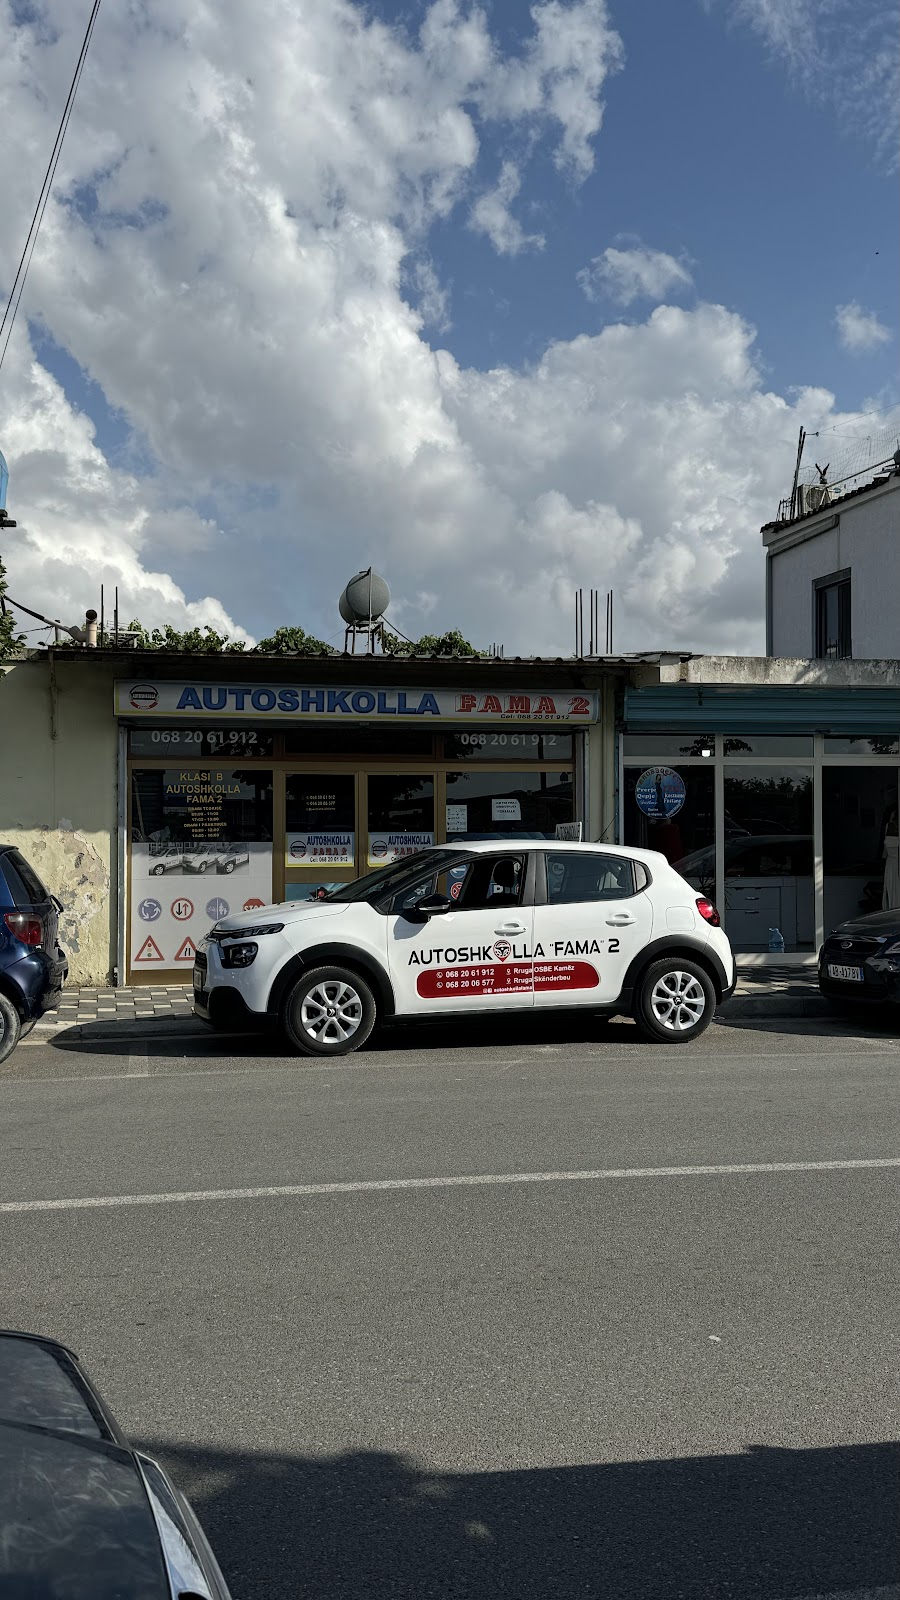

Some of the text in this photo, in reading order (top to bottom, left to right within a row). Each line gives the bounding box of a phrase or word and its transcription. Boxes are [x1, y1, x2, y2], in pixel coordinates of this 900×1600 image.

[176, 687, 441, 715] AUTOSHKOLLA
[455, 694, 590, 714] FAMA 2
[151, 730, 258, 744] 068 20 61 912
[460, 734, 556, 746] 068 20 61 912
[166, 785, 240, 793] AUTOSHKOLLA
[306, 836, 351, 845] AUTOSHKOLLA
[388, 836, 431, 845] AUTOSHKOLLA
[608, 938, 620, 953] 2
